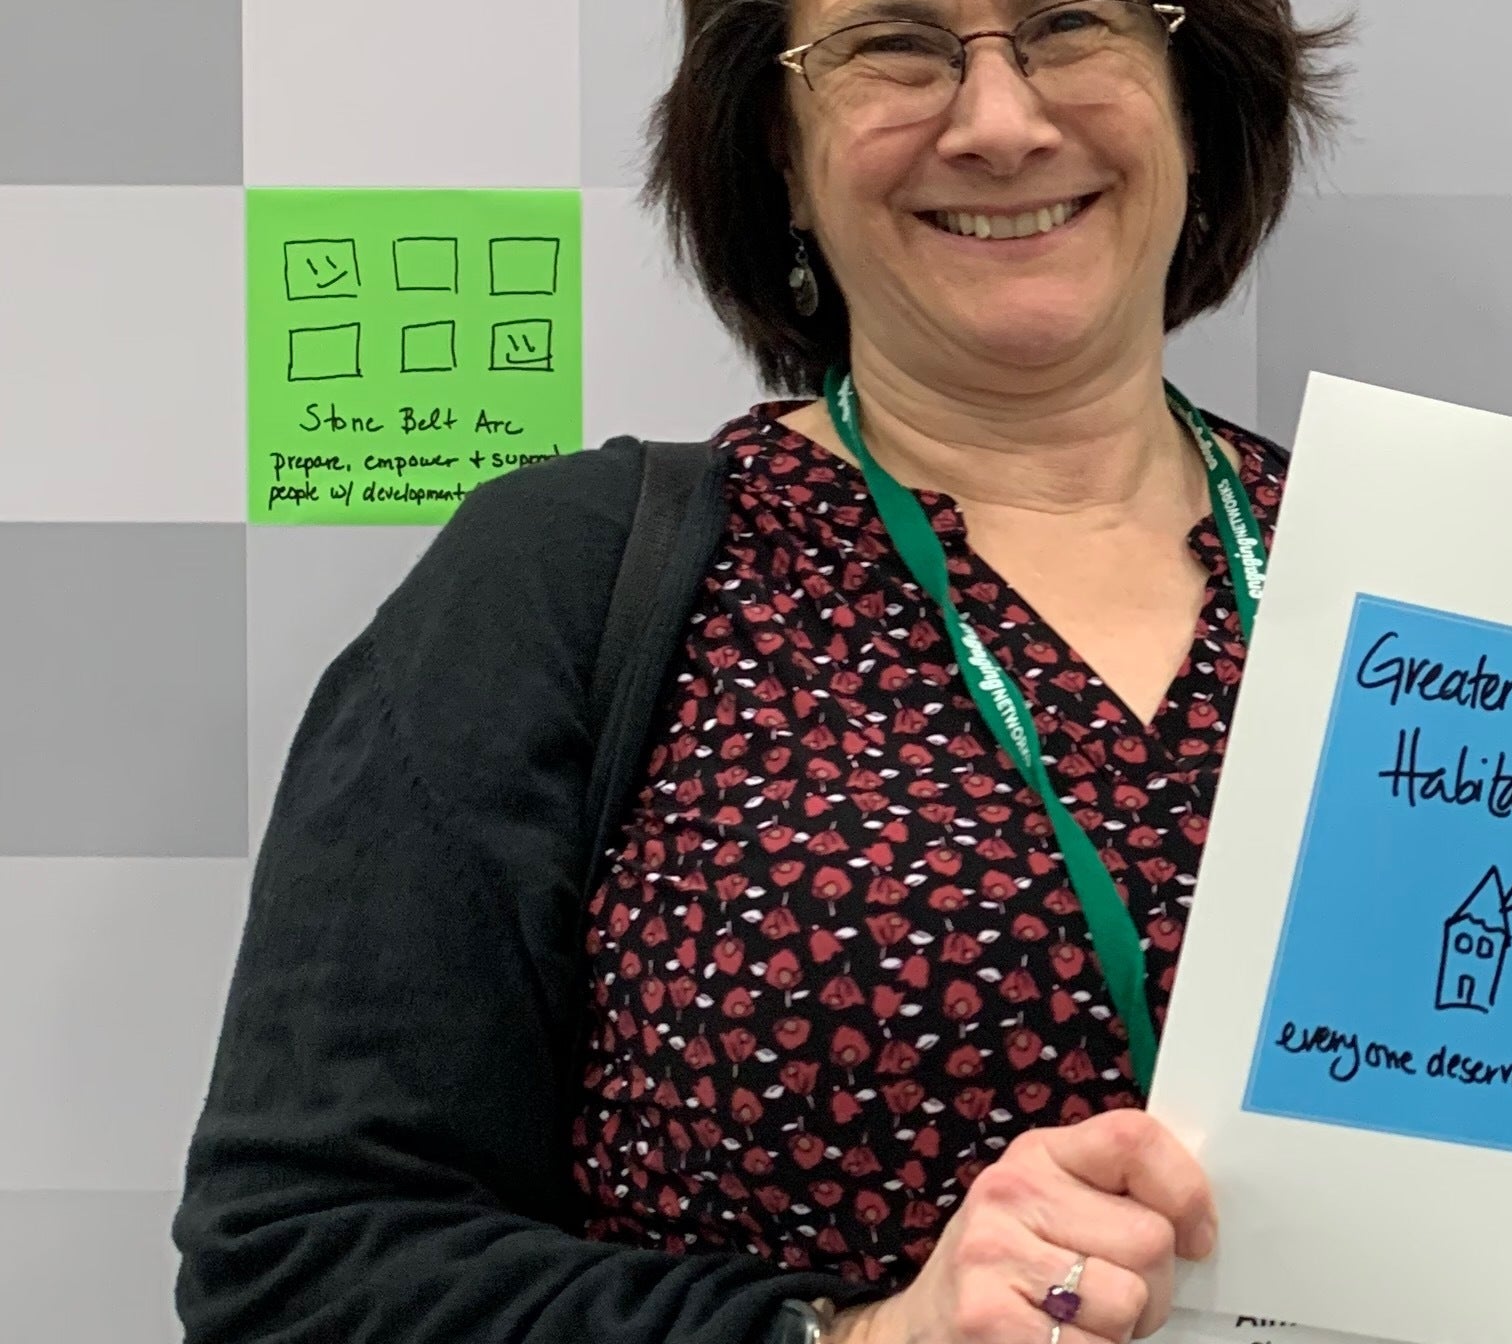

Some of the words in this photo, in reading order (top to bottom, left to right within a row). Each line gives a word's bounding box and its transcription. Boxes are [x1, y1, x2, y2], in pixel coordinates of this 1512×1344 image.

[299, 402, 384, 433] Stone
[399, 406, 456, 435] Belt
[474, 409, 524, 435] Arc
[364, 454, 462, 477] empower
[268, 481, 320, 511] people
[330, 480, 354, 506] w/
